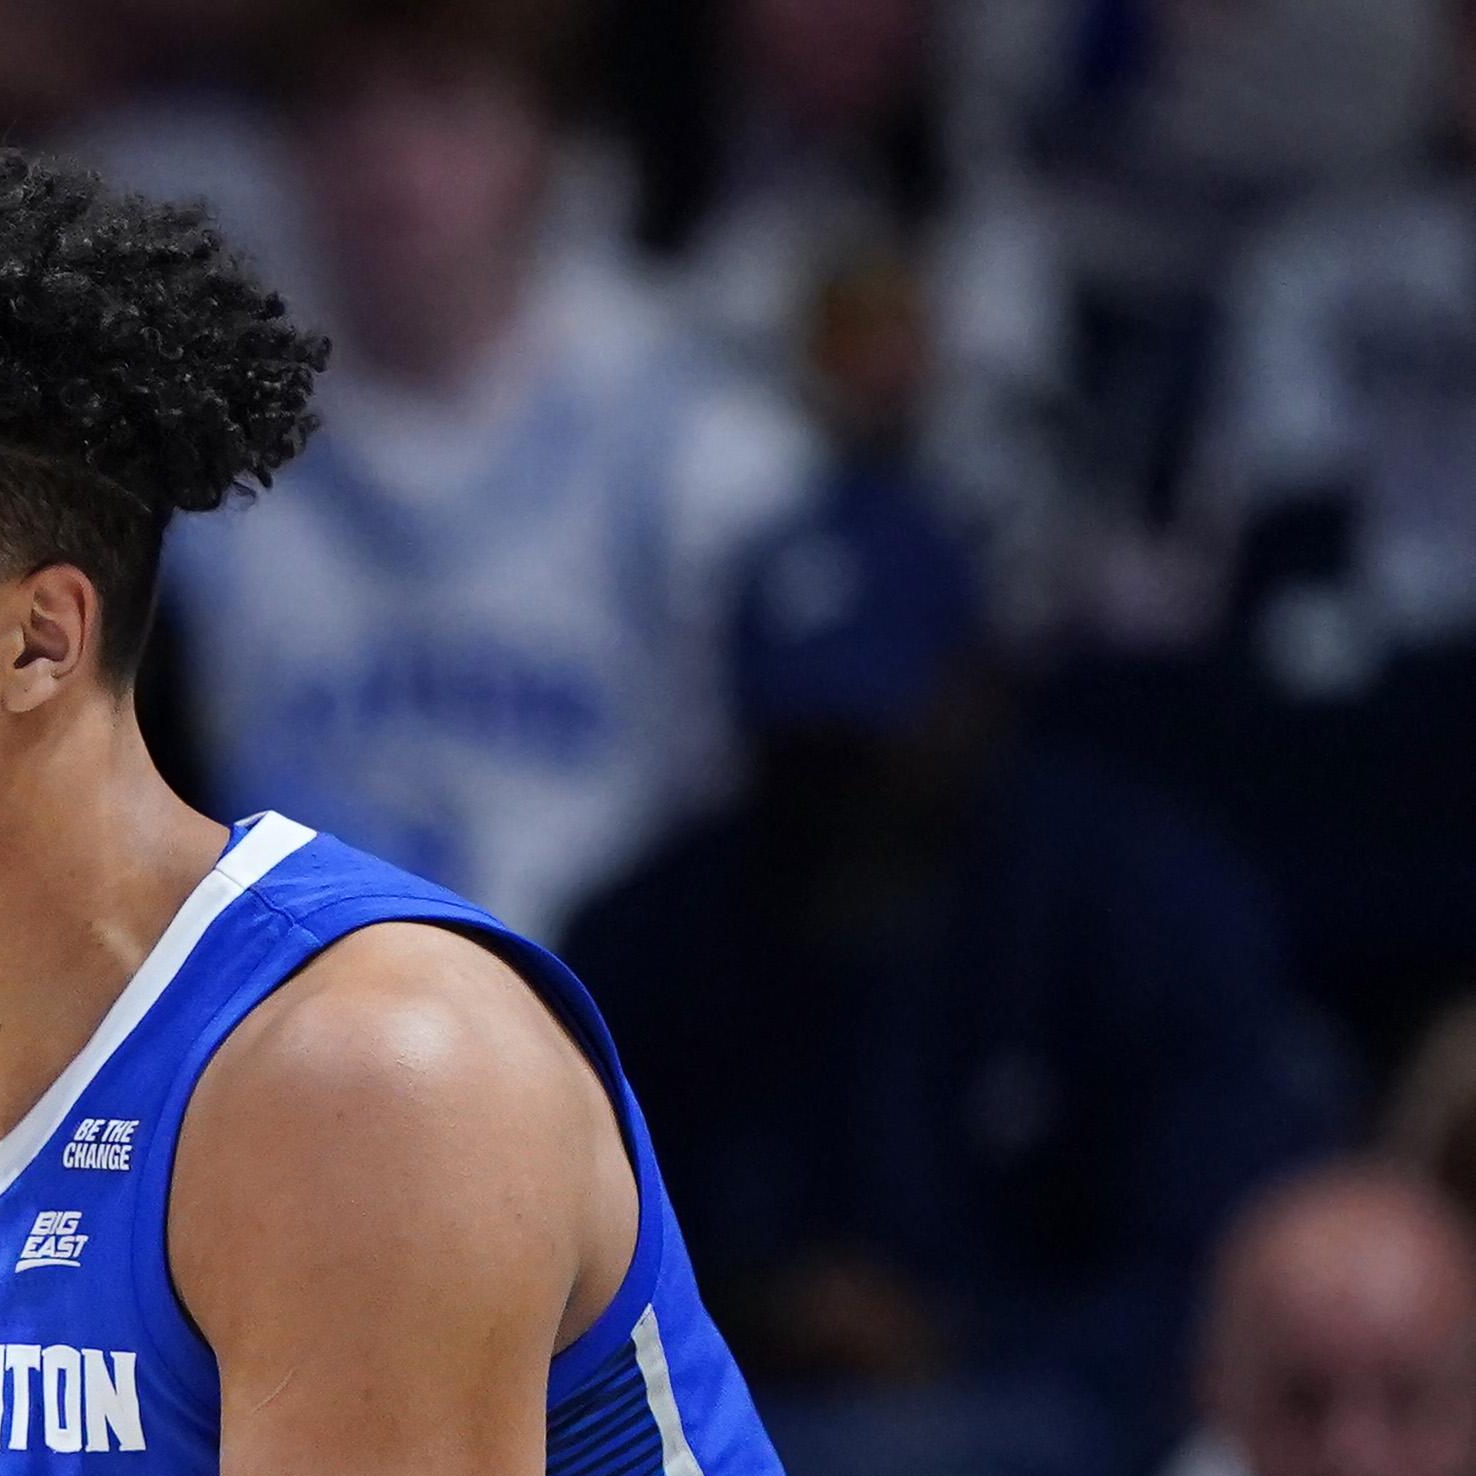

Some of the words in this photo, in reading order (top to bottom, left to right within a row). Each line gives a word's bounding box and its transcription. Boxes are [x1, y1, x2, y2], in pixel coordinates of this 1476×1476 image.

[74, 1118, 105, 1142] BE
[102, 1119, 139, 1143] THE
[63, 1142, 132, 1170] CHANGE
[30, 1211, 82, 1235] BIG
[20, 1234, 88, 1259] EAST
